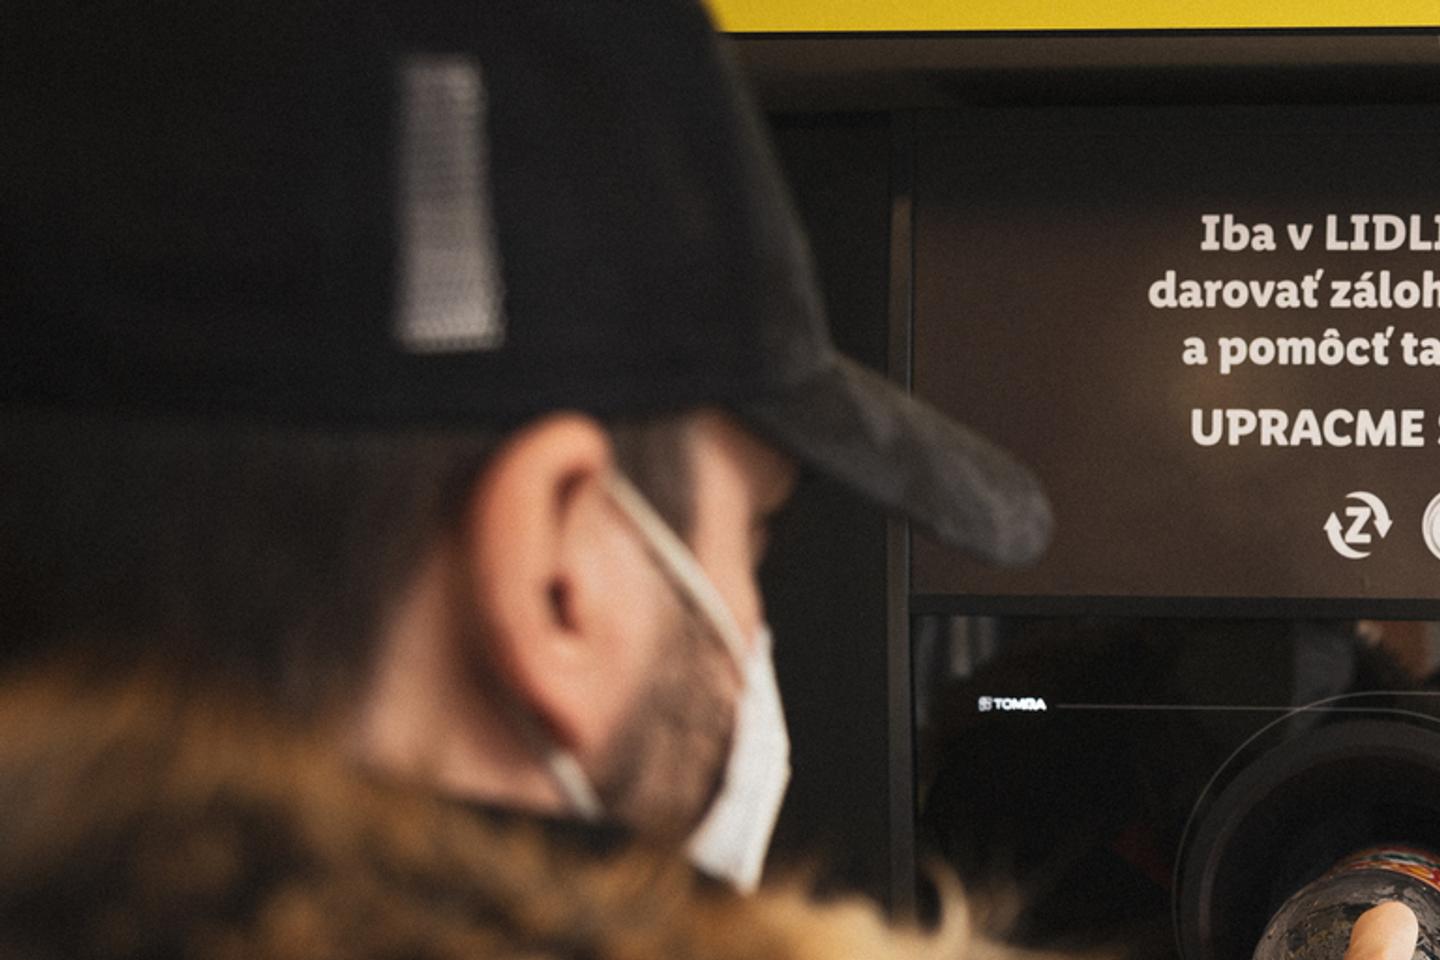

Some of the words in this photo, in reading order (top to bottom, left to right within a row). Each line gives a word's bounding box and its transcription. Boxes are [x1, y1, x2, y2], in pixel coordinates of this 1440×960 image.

[1200, 213, 1277, 251] Iba
[1287, 224, 1313, 251] v
[1148, 268, 1324, 309] darovať
[1182, 337, 1209, 366] a
[1218, 325, 1395, 375] pomôcť
[1191, 408, 1425, 447] UPRACME
